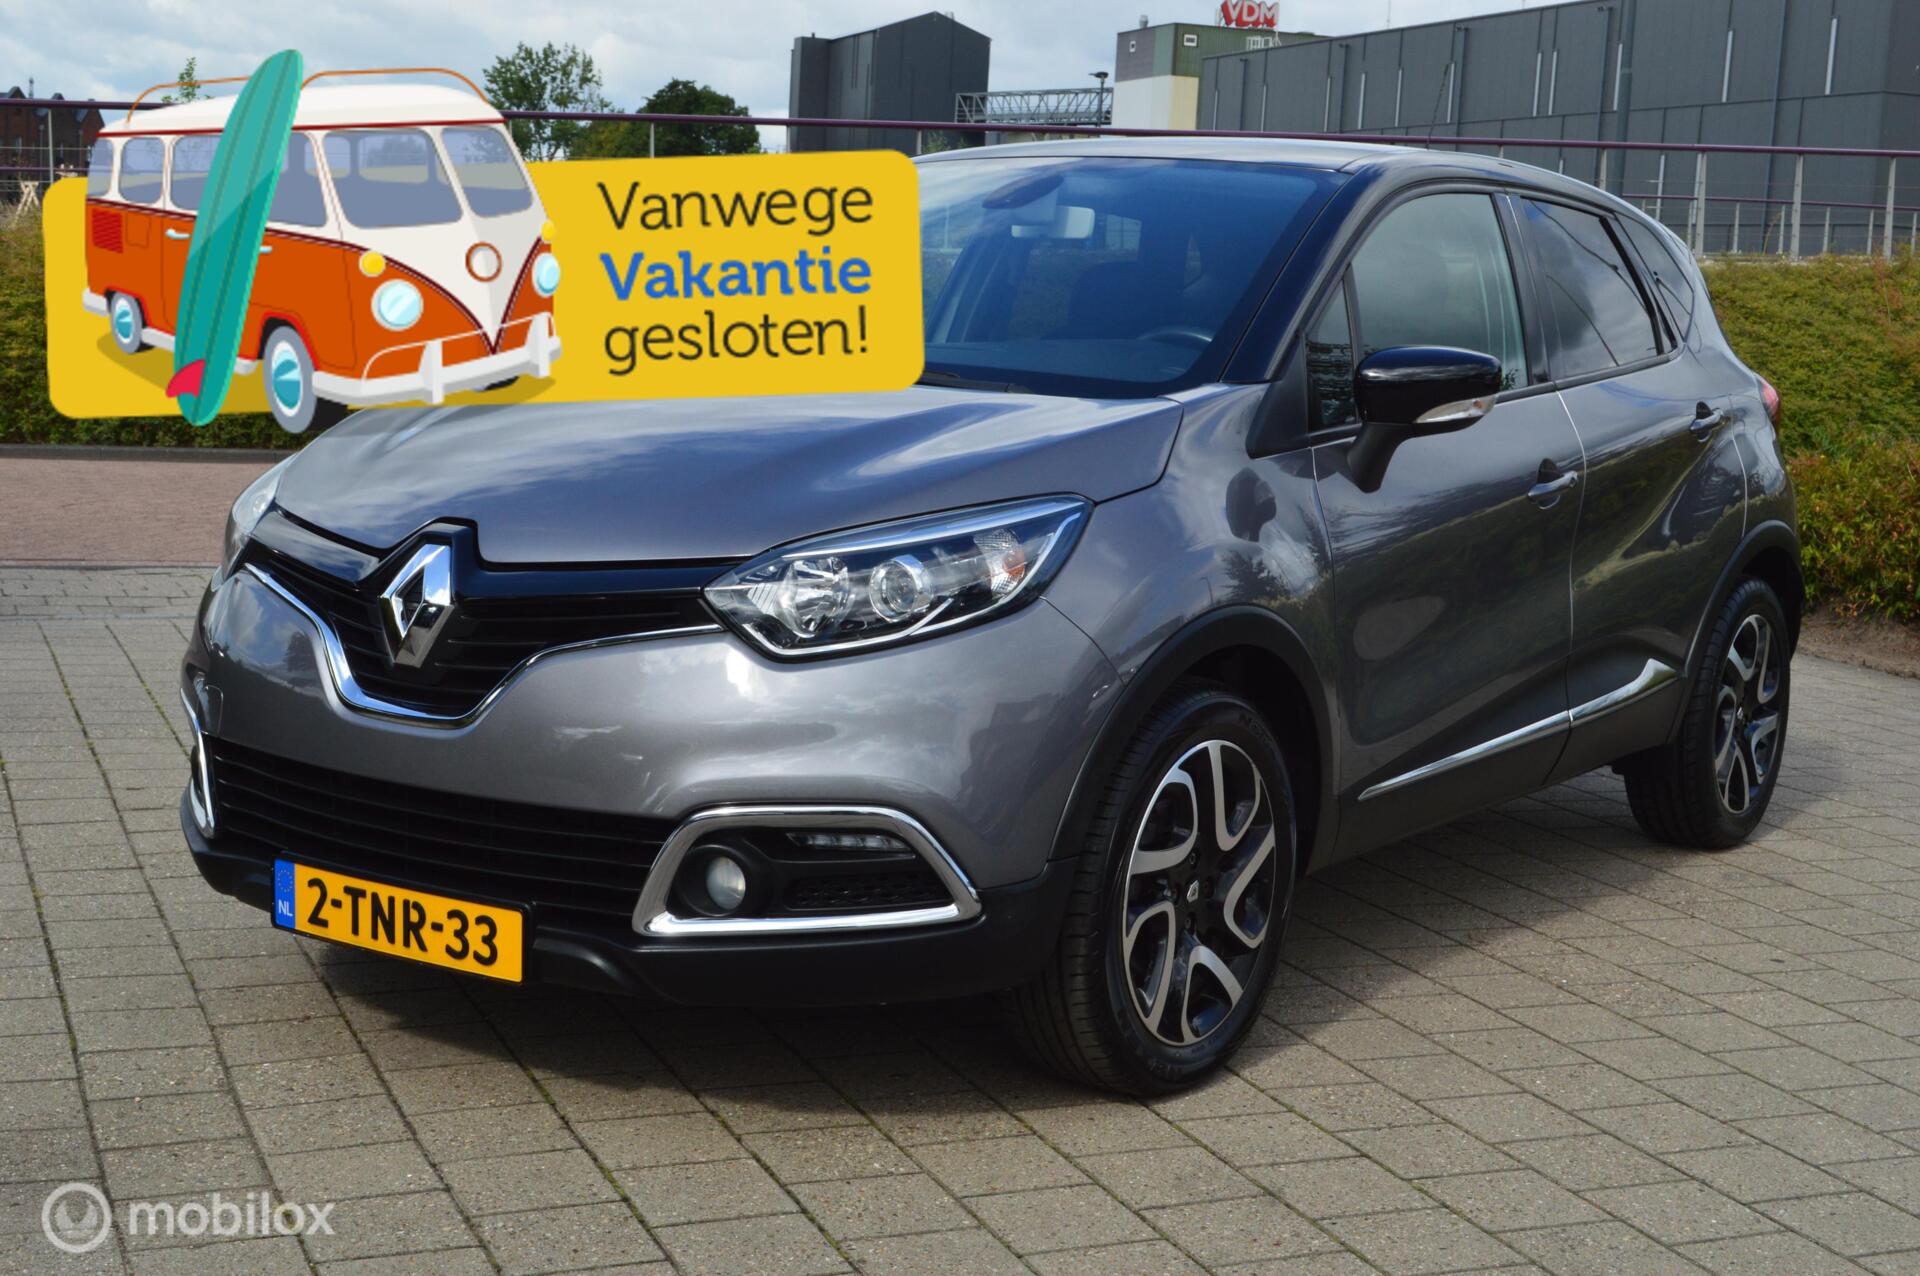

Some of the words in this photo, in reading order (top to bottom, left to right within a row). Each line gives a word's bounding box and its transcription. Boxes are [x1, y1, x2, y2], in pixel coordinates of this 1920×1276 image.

[1221, 0, 1281, 28] VDM
[278, 899, 294, 917] NL
[307, 877, 498, 966] 2-TNR-33
